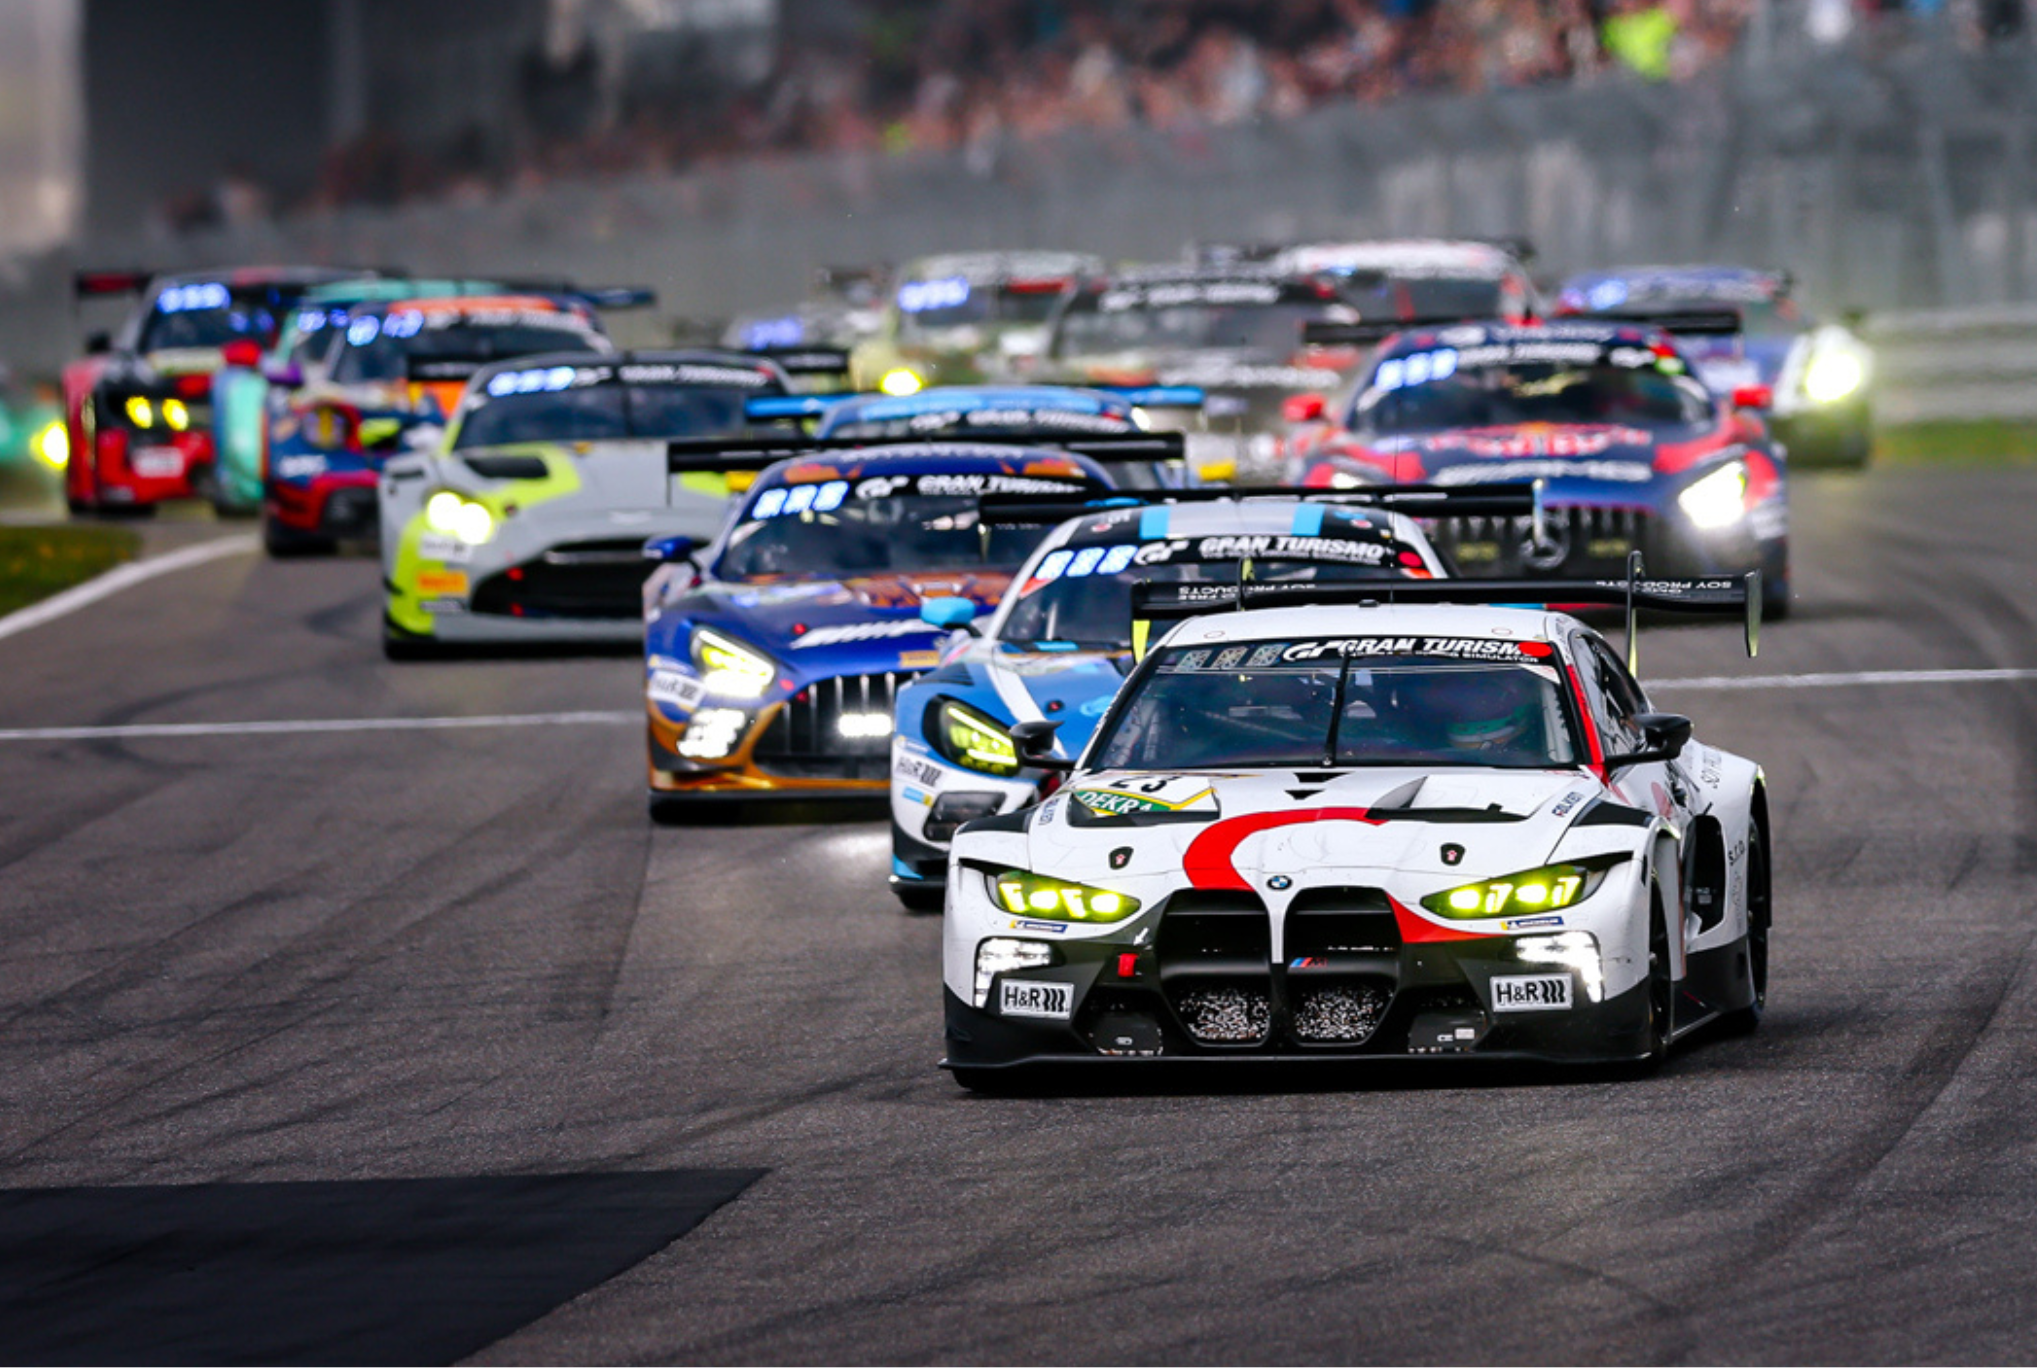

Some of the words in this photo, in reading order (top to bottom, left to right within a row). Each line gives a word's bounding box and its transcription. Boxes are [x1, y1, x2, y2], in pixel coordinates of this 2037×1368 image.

[1199, 536, 1272, 554] GRAN
[1275, 537, 1384, 559] TURISMO
[1338, 638, 1417, 653] GRAN
[1423, 638, 1523, 656] TURISM
[1080, 791, 1153, 814] DEKRA
